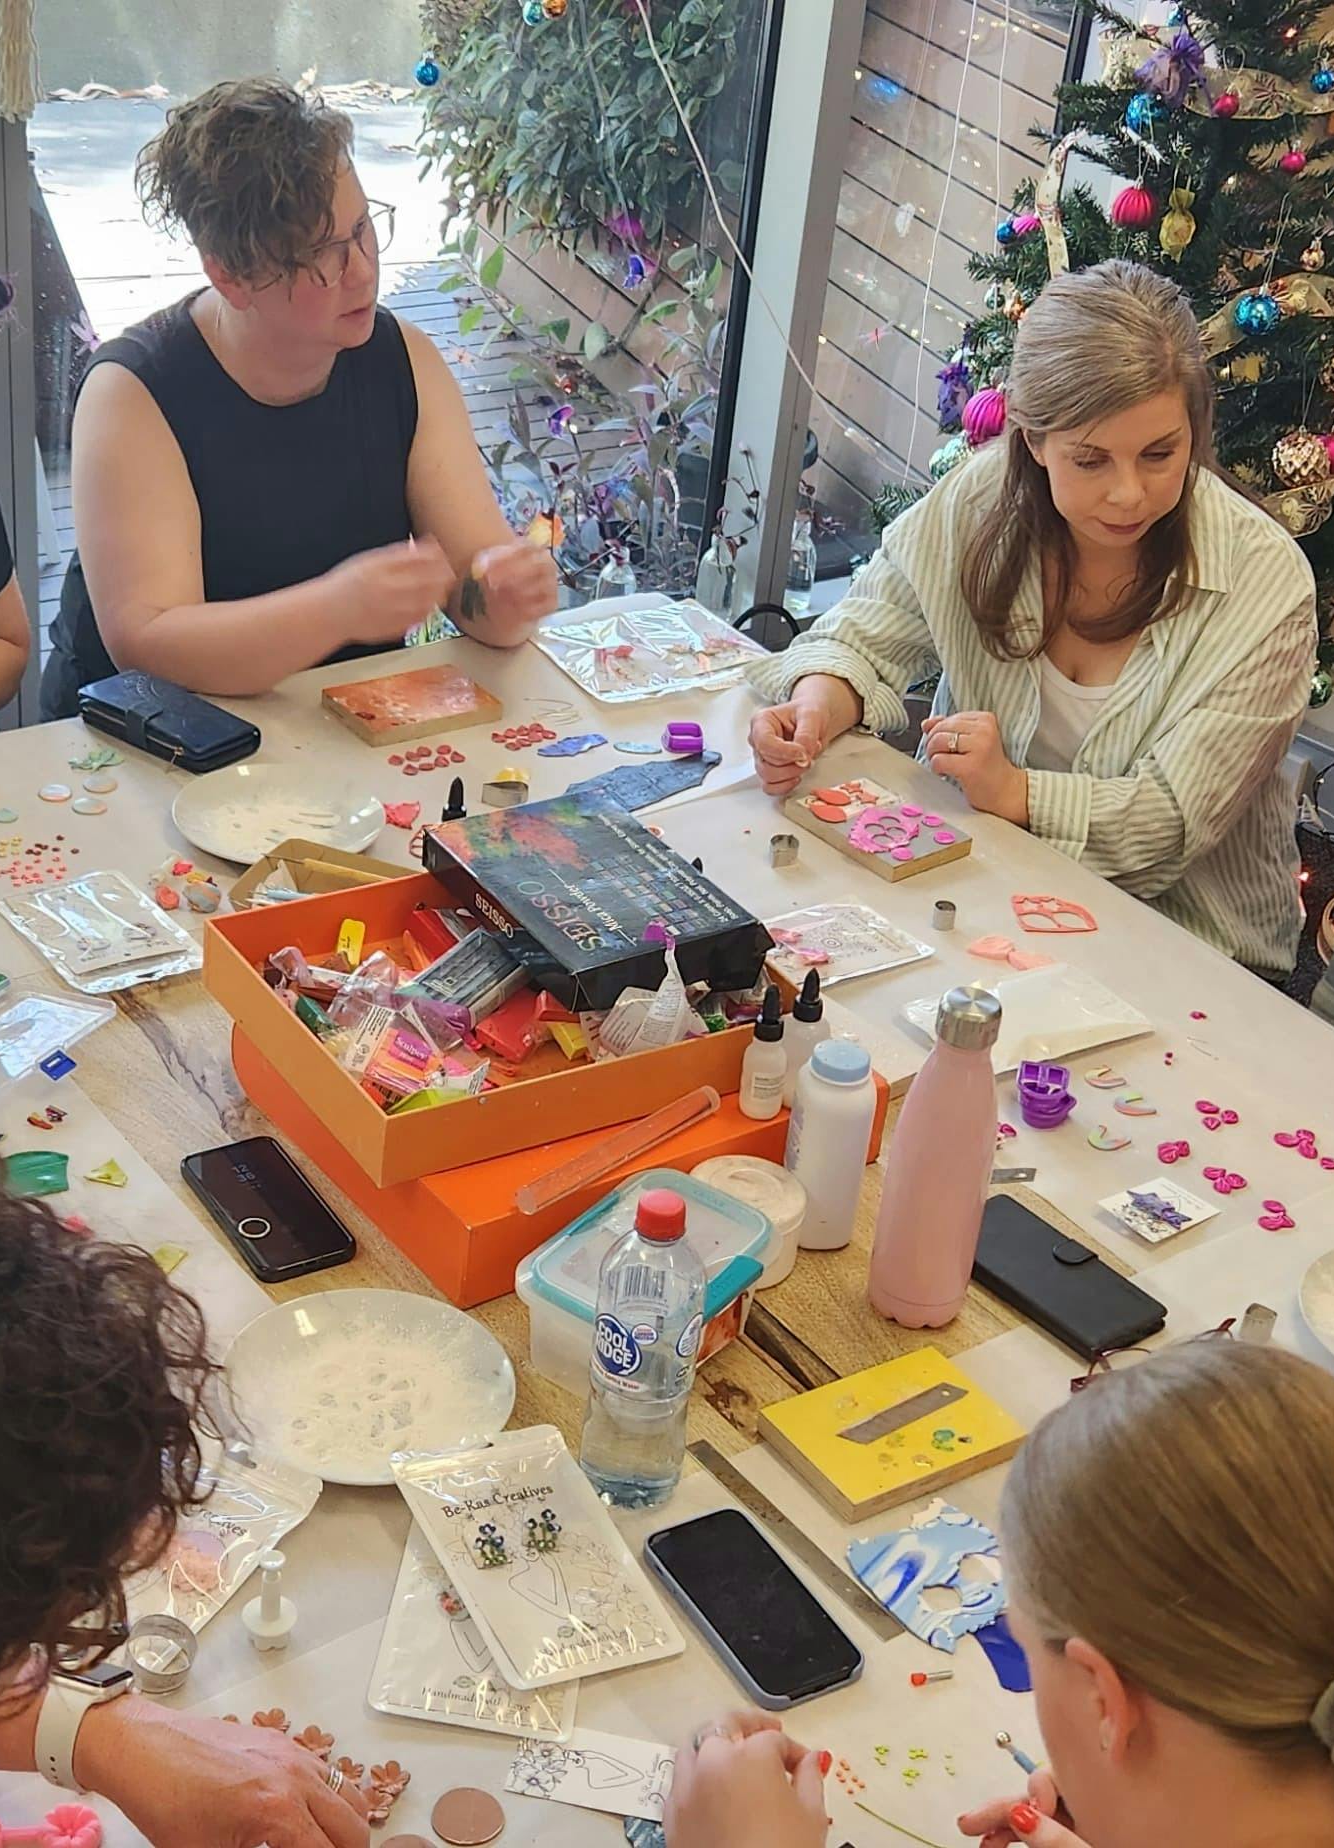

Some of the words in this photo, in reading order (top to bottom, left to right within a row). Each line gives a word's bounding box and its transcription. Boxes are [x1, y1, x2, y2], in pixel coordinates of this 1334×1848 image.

[564, 884, 602, 913] Powder
[475, 893, 514, 938] SEISSO
[518, 881, 606, 951] SEISSO
[596, 910, 622, 932] Mica
[395, 1035, 428, 1060] Sculpey
[597, 1320, 631, 1353] COOL
[491, 1483, 555, 1505] Creatives
